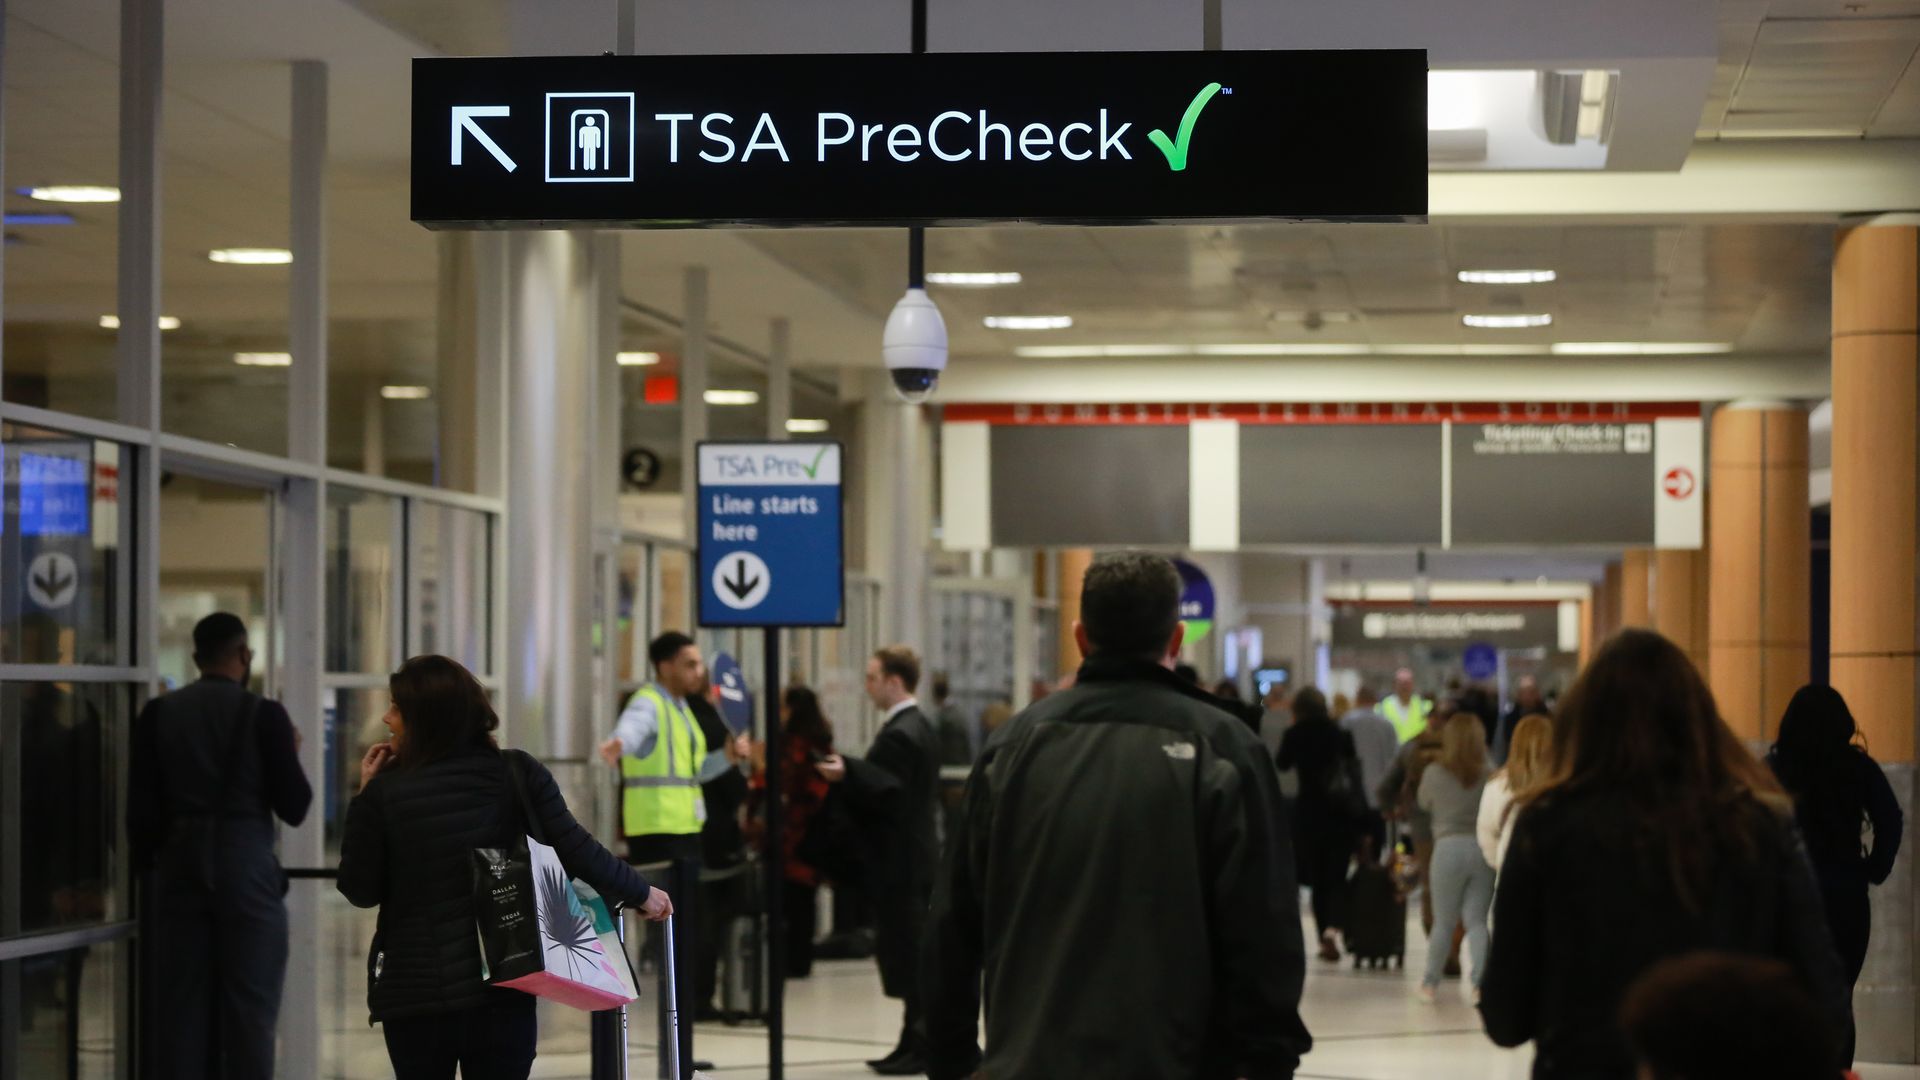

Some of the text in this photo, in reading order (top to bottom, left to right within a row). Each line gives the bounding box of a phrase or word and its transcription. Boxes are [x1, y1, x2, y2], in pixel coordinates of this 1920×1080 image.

[654, 112, 790, 163] TSA
[817, 108, 1133, 162] PreCheck
[1499, 402, 1630, 422] SOUTH
[715, 455, 801, 478] TSA Pre
[712, 494, 819, 515] Line starts
[712, 520, 758, 541] here
[492, 883, 517, 895] DALLAS
